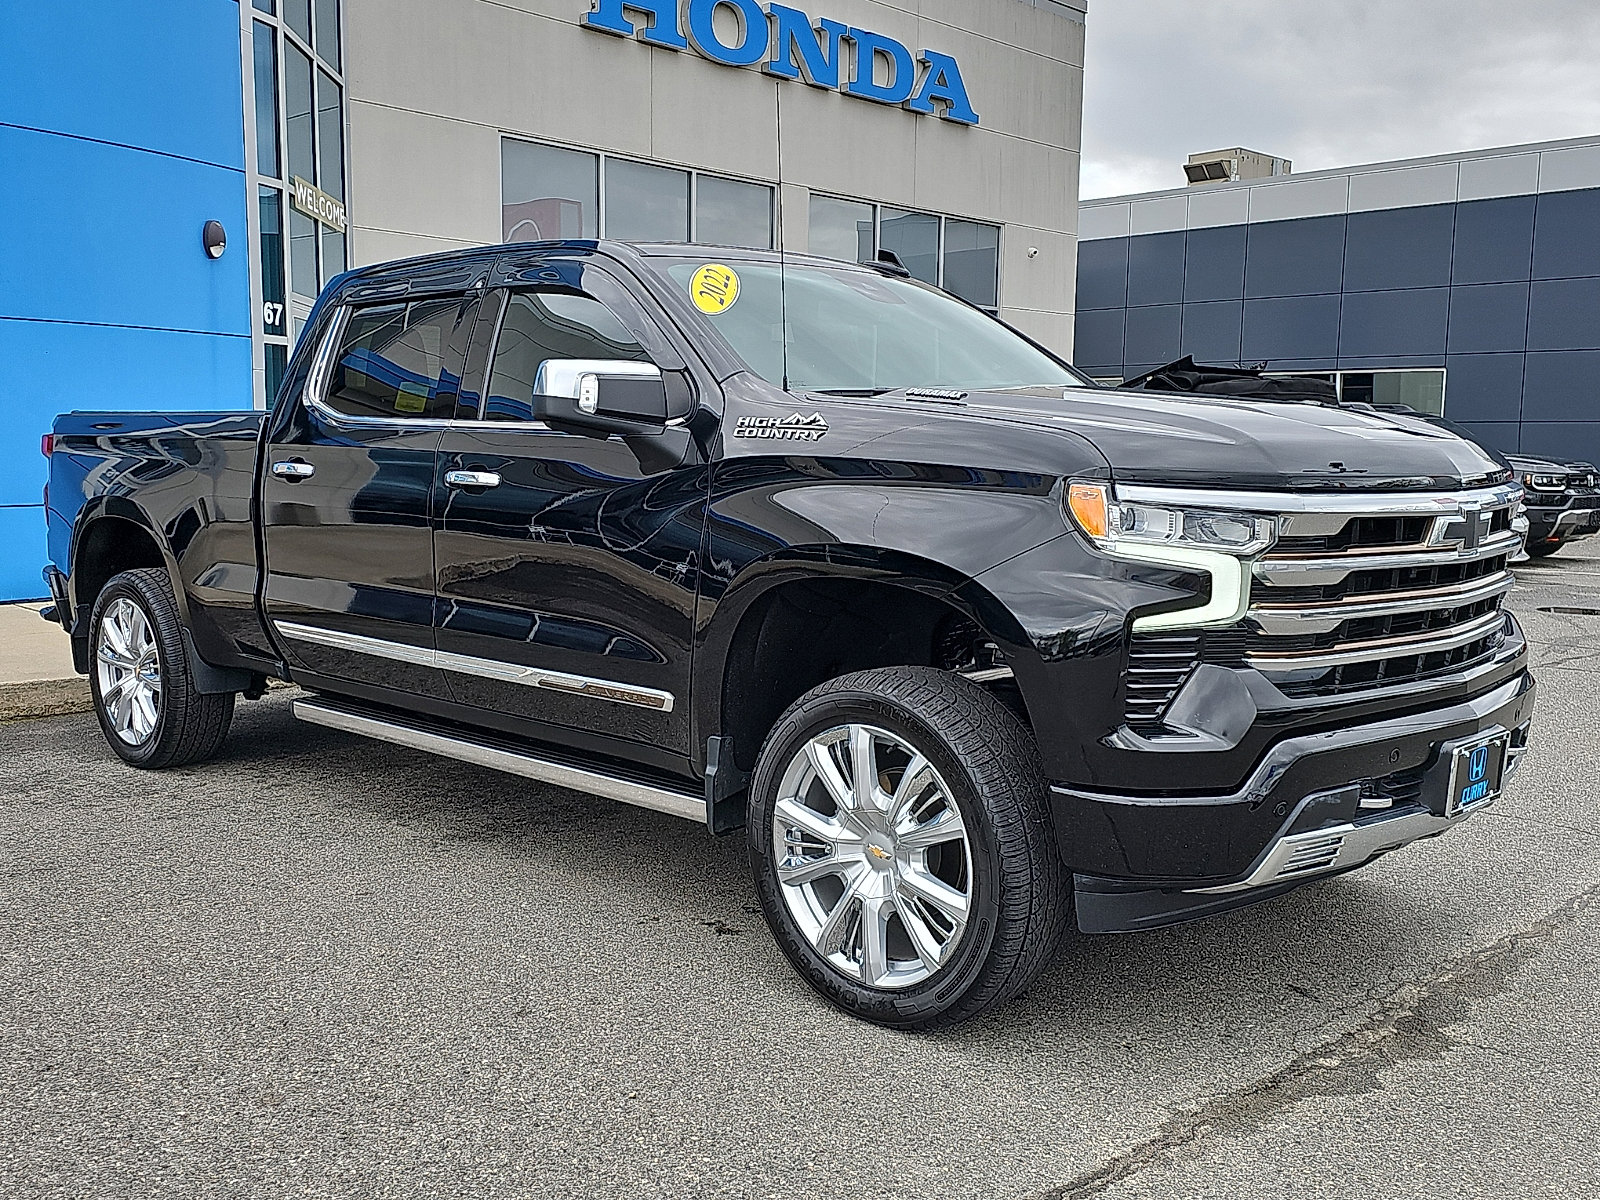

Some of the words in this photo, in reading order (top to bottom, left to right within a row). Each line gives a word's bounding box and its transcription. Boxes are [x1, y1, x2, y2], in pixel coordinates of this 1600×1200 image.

[295, 181, 345, 227] WELCOME
[699, 268, 730, 306] 2022
[263, 302, 283, 326] 67
[905, 387, 968, 400] DURAMAX
[736, 416, 783, 428] HIGH
[733, 428, 827, 441] COUNTRY
[1462, 779, 1489, 804] CURRY
